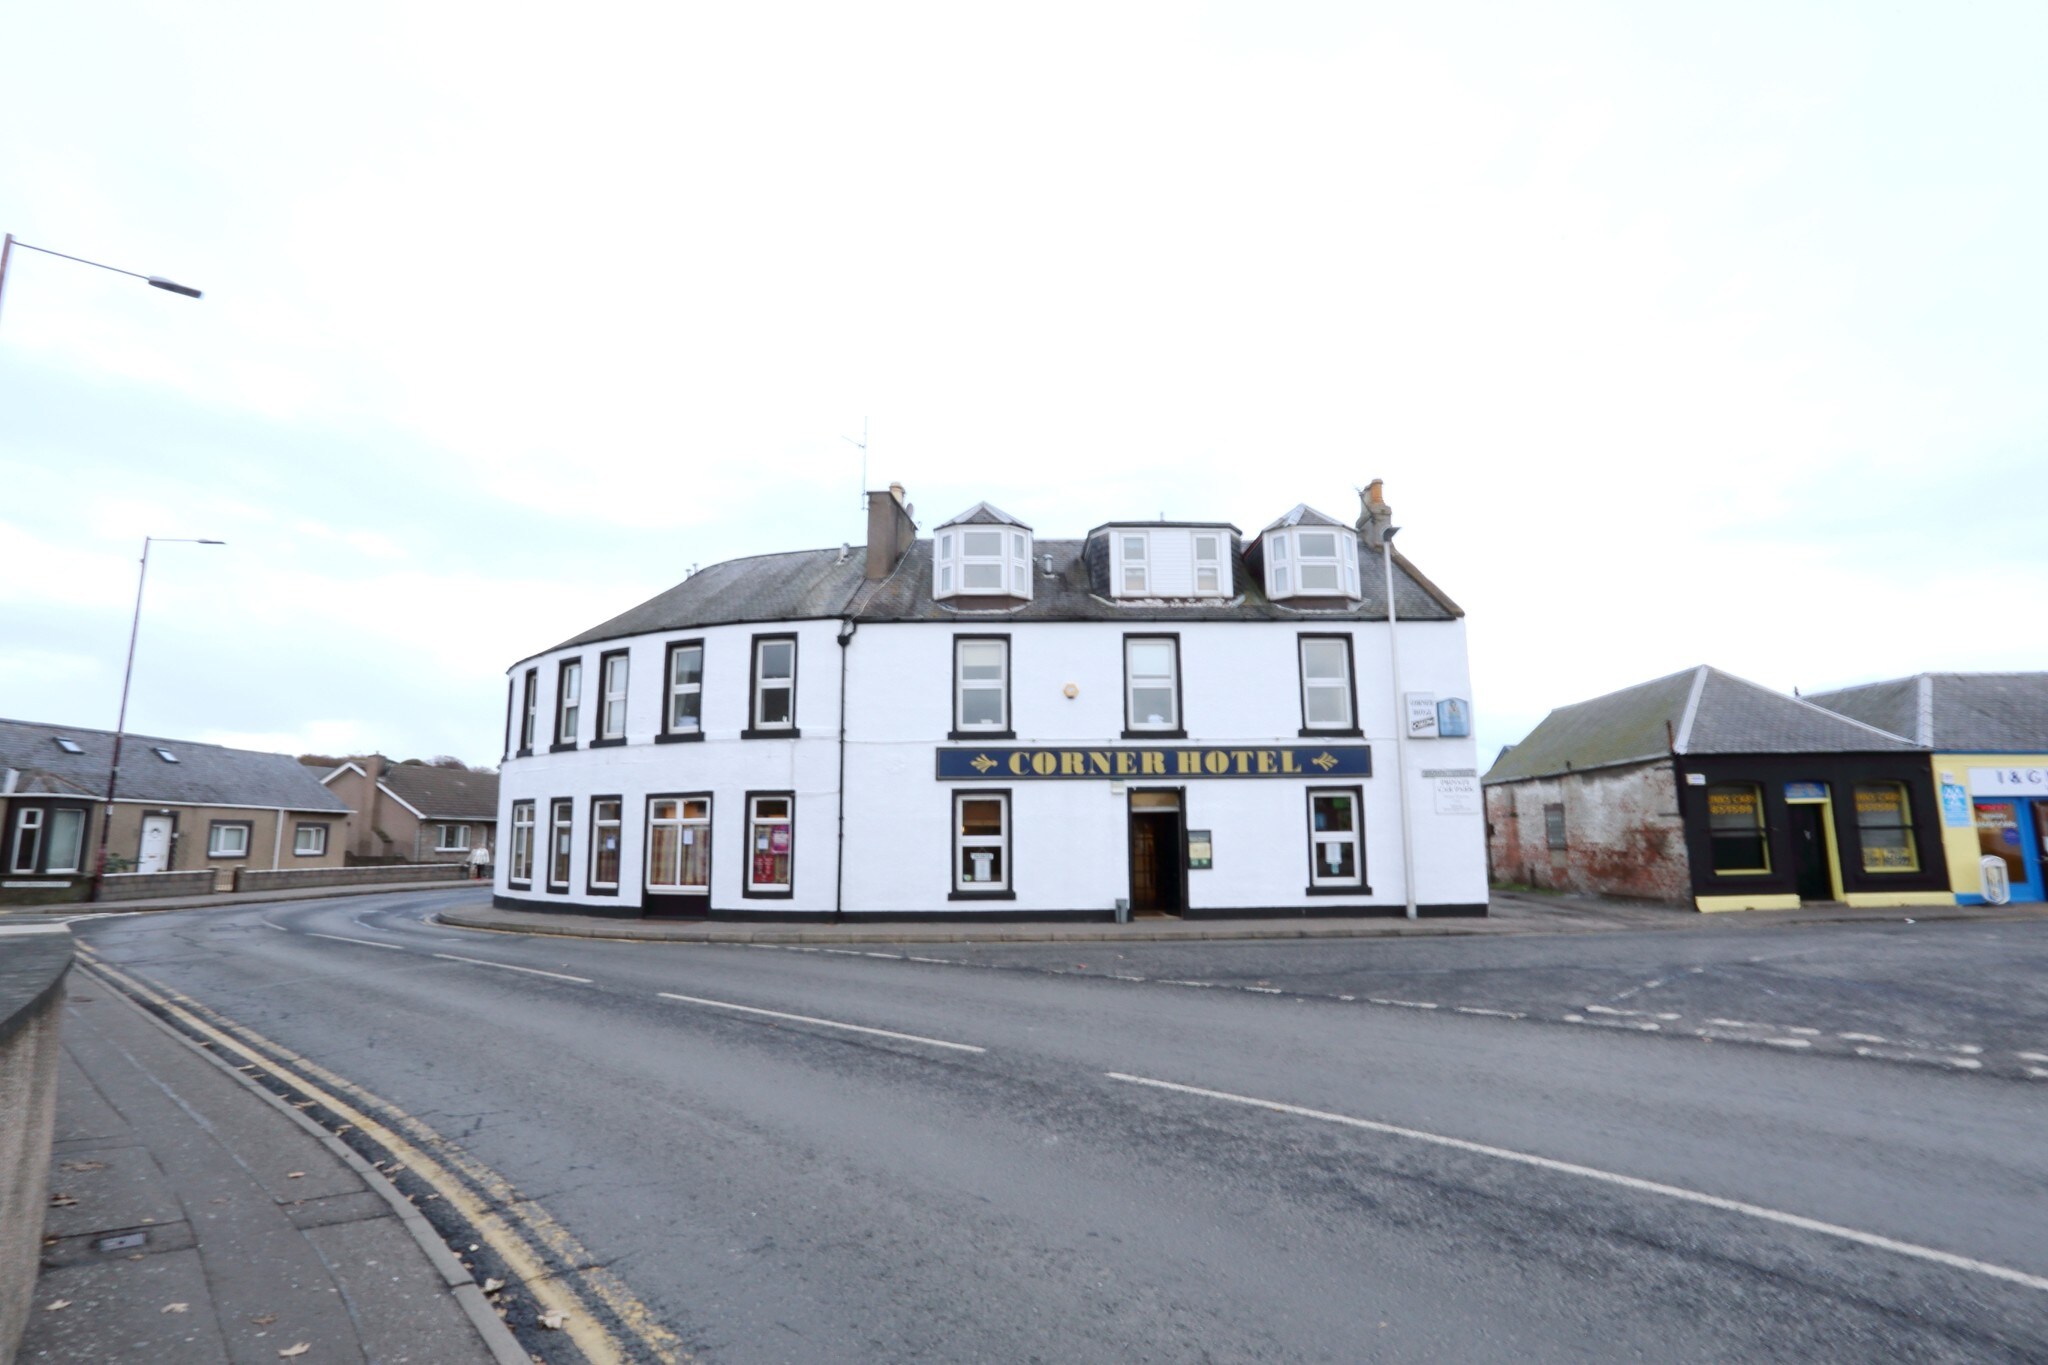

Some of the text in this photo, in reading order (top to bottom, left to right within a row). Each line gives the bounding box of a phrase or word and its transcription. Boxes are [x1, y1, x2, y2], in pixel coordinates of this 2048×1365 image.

[1008, 750, 1302, 775] CORNER HOTEL
[2009, 770, 2022, 784] &
